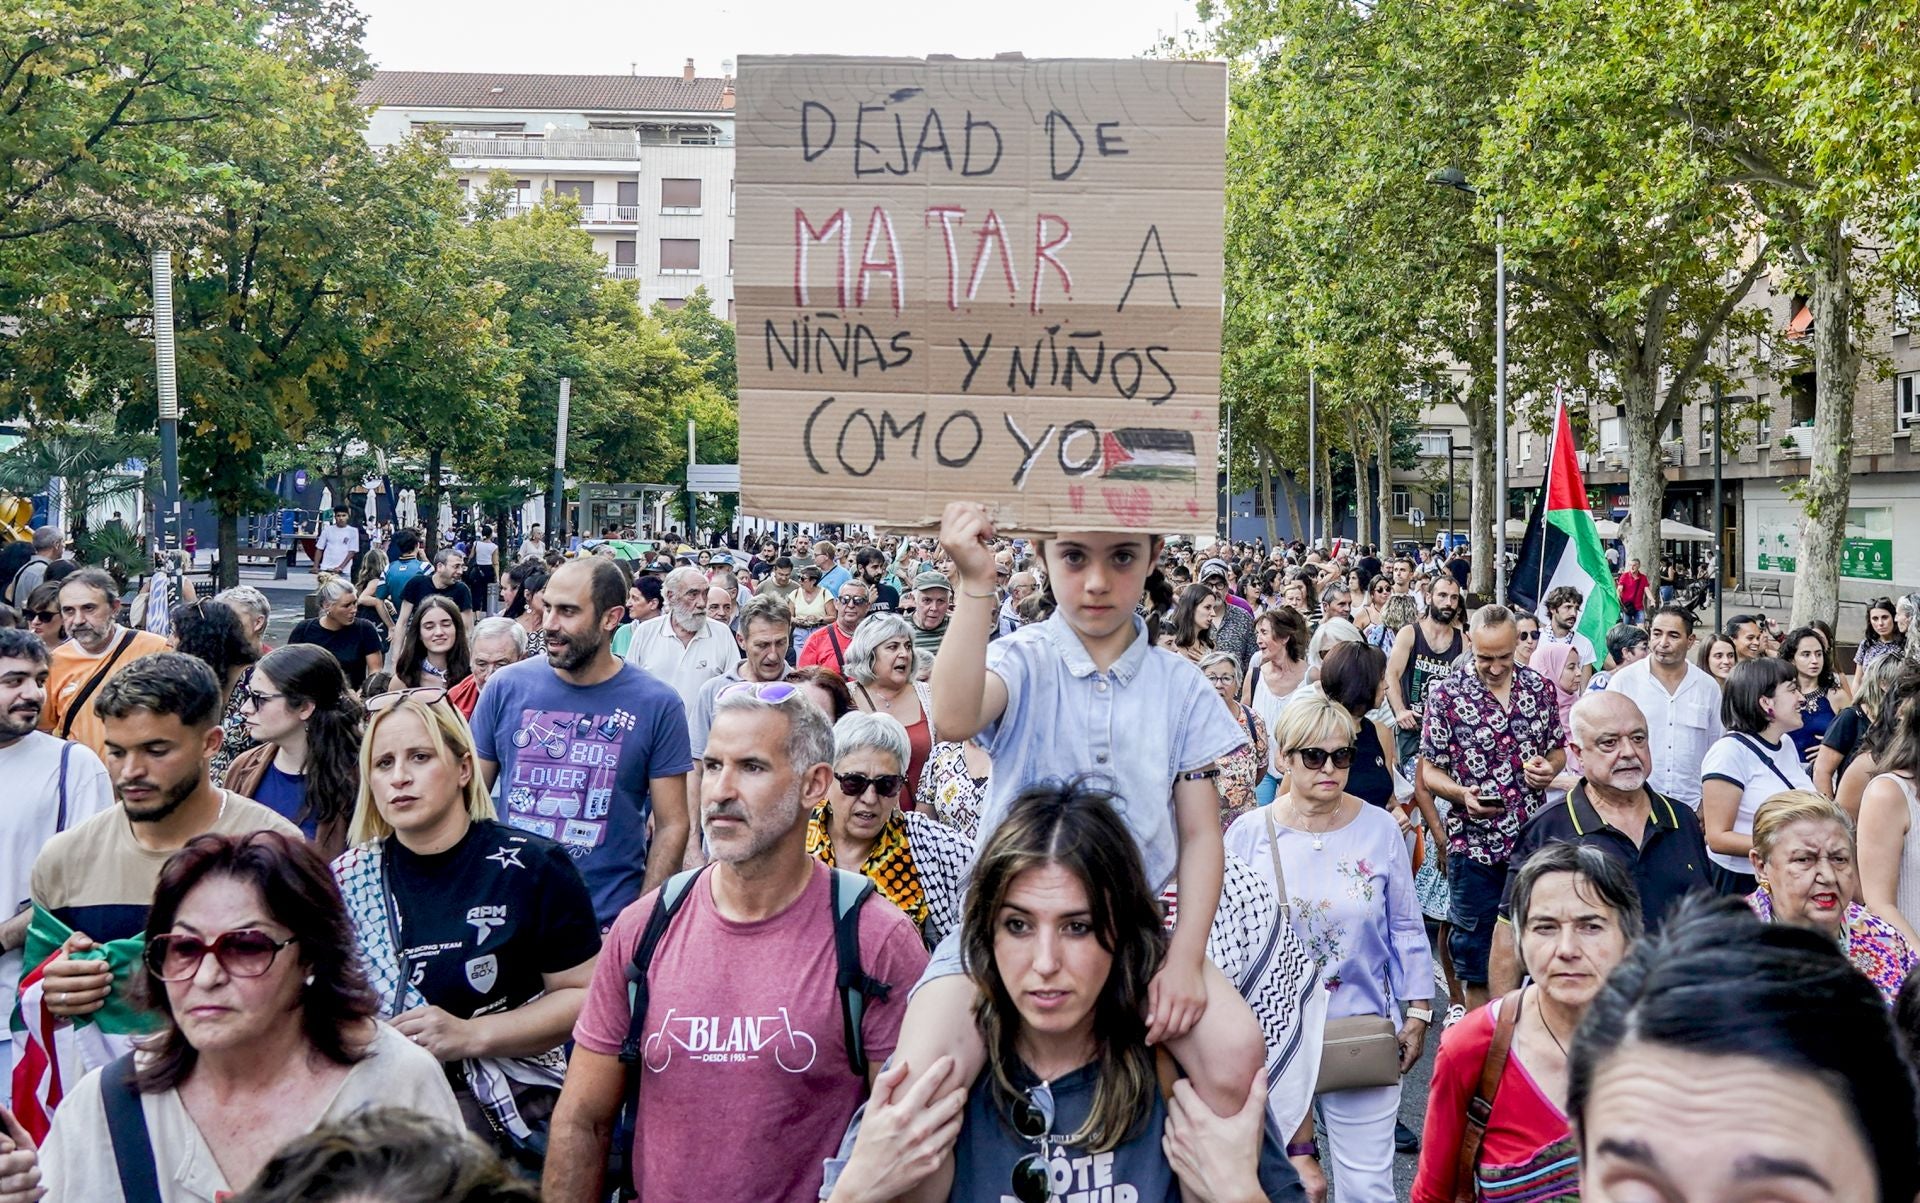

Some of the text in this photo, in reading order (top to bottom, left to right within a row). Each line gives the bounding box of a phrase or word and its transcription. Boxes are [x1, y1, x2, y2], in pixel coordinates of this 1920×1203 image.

[1045, 110, 1128, 180] DE
[795, 206, 1198, 314] MATAR A
[766, 313, 913, 377] NIÑAS
[958, 333, 991, 391] Y
[803, 397, 1102, 491] COMO YO
[569, 742, 617, 767] 80's
[514, 765, 587, 789] LOVER
[466, 904, 507, 919] RPM
[439, 941, 463, 950] TEAM
[471, 968, 495, 980] BOX
[473, 961, 490, 972] PIT
[688, 1016, 762, 1052] BLAN
[702, 1053, 746, 1063] DESDE 1955
[1050, 1146, 1114, 1195] ÔTE
